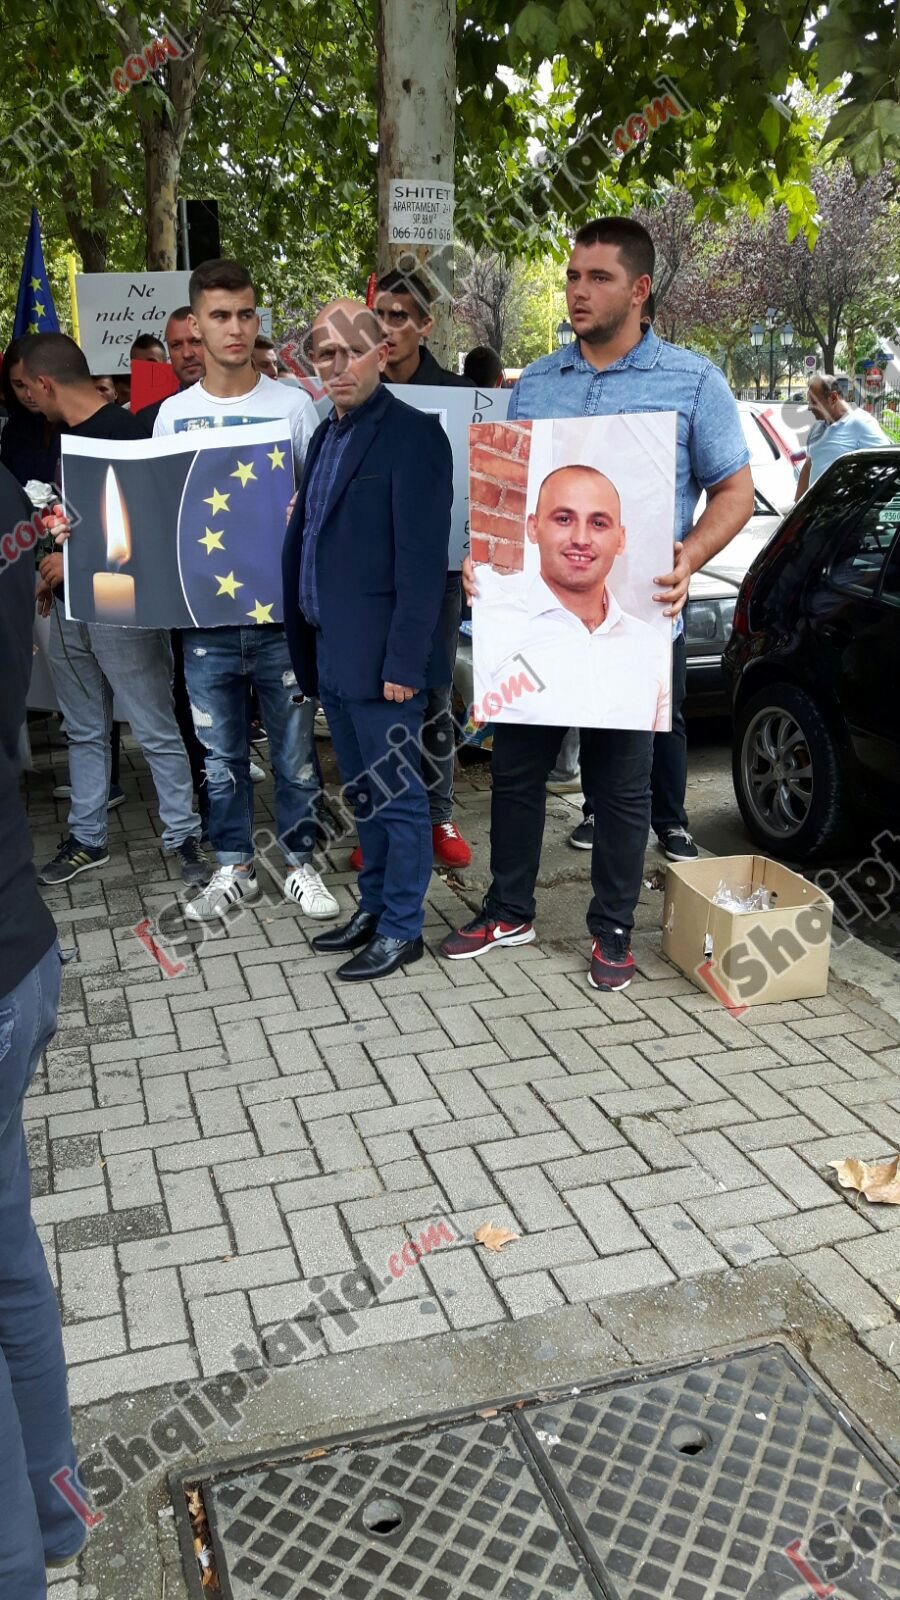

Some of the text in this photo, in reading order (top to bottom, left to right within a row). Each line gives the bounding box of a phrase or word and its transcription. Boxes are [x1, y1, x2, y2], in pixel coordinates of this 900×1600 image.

[394, 186, 451, 201] SHITET
[392, 201, 440, 213] APARTAMENT
[392, 226, 411, 239] 066
[413, 227, 426, 239] 70
[127, 284, 155, 298] Ne
[96, 305, 166, 323] nuk do
